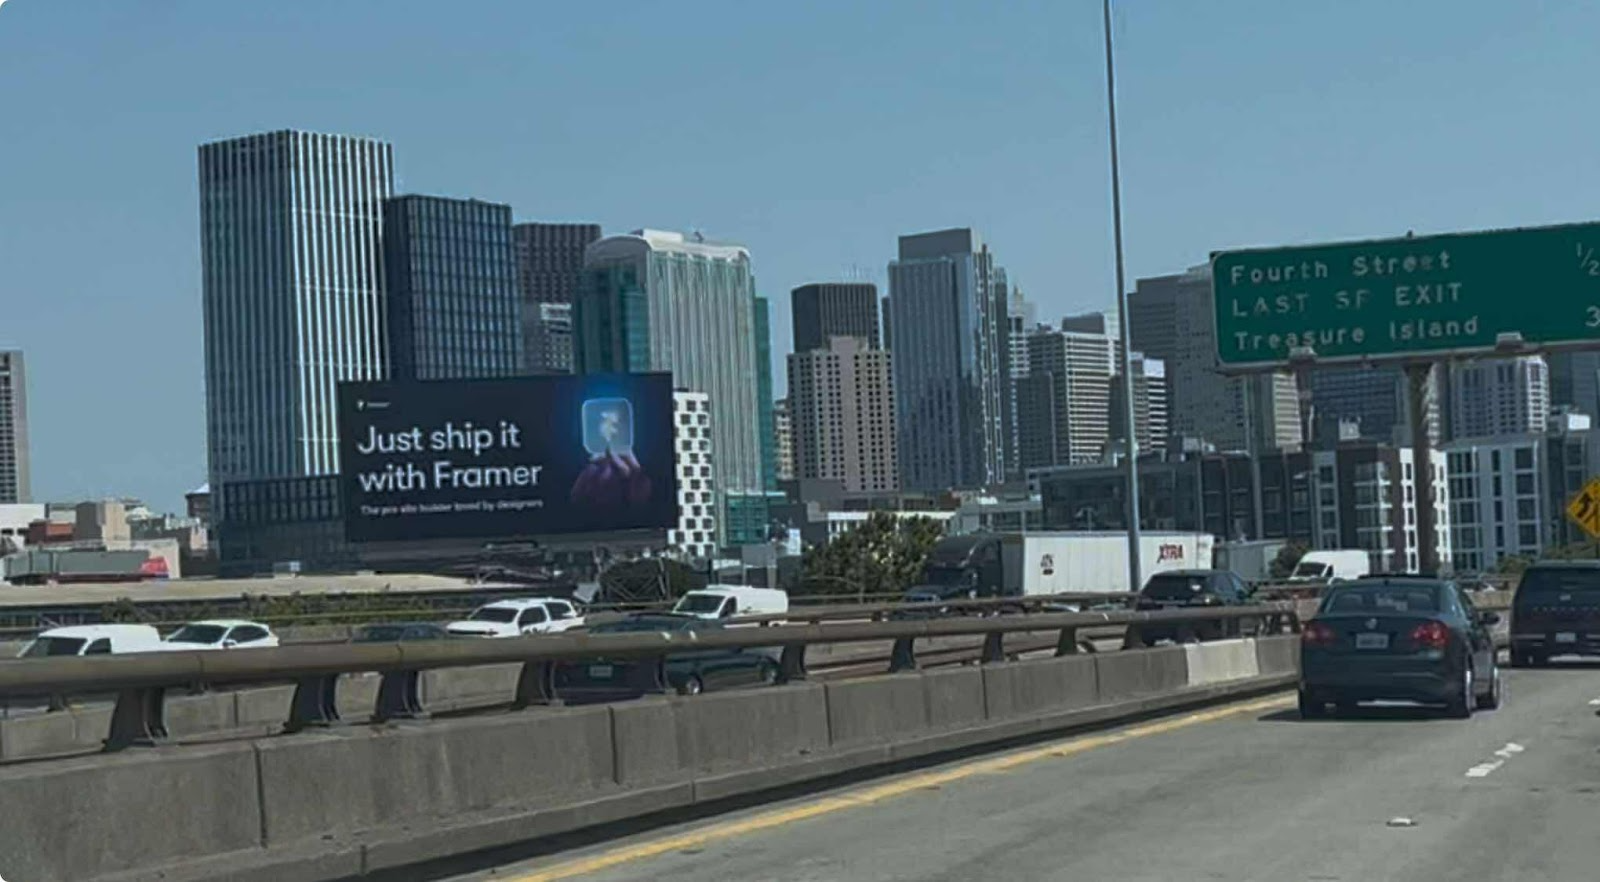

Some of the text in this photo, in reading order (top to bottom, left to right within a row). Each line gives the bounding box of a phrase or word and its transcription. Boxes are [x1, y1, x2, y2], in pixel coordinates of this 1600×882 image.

[1230, 250, 1450, 286] Fourth Street
[1232, 281, 1462, 317] LAST SF EXIT
[1234, 315, 1479, 350] Treasure Island
[358, 421, 520, 456] Just ship it
[358, 459, 543, 492] with Framer
